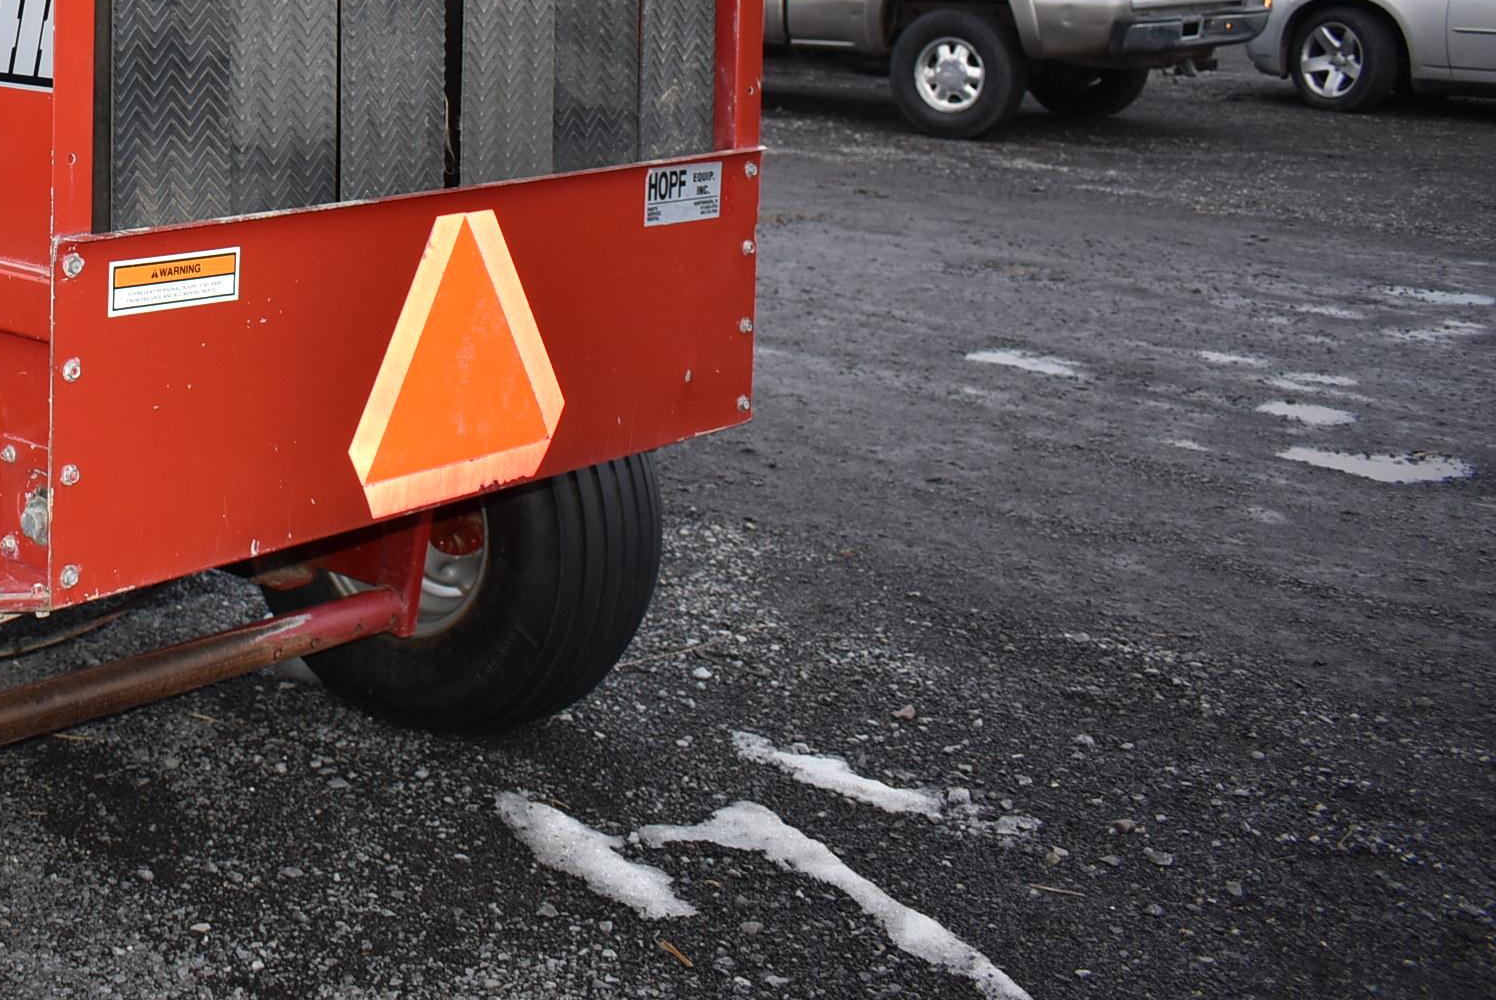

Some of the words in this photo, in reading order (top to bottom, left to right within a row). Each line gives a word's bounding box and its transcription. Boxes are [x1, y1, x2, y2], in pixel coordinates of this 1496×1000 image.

[648, 169, 687, 201] HOPF
[693, 170, 716, 182] EQUIP.
[159, 263, 201, 277] WARNING
